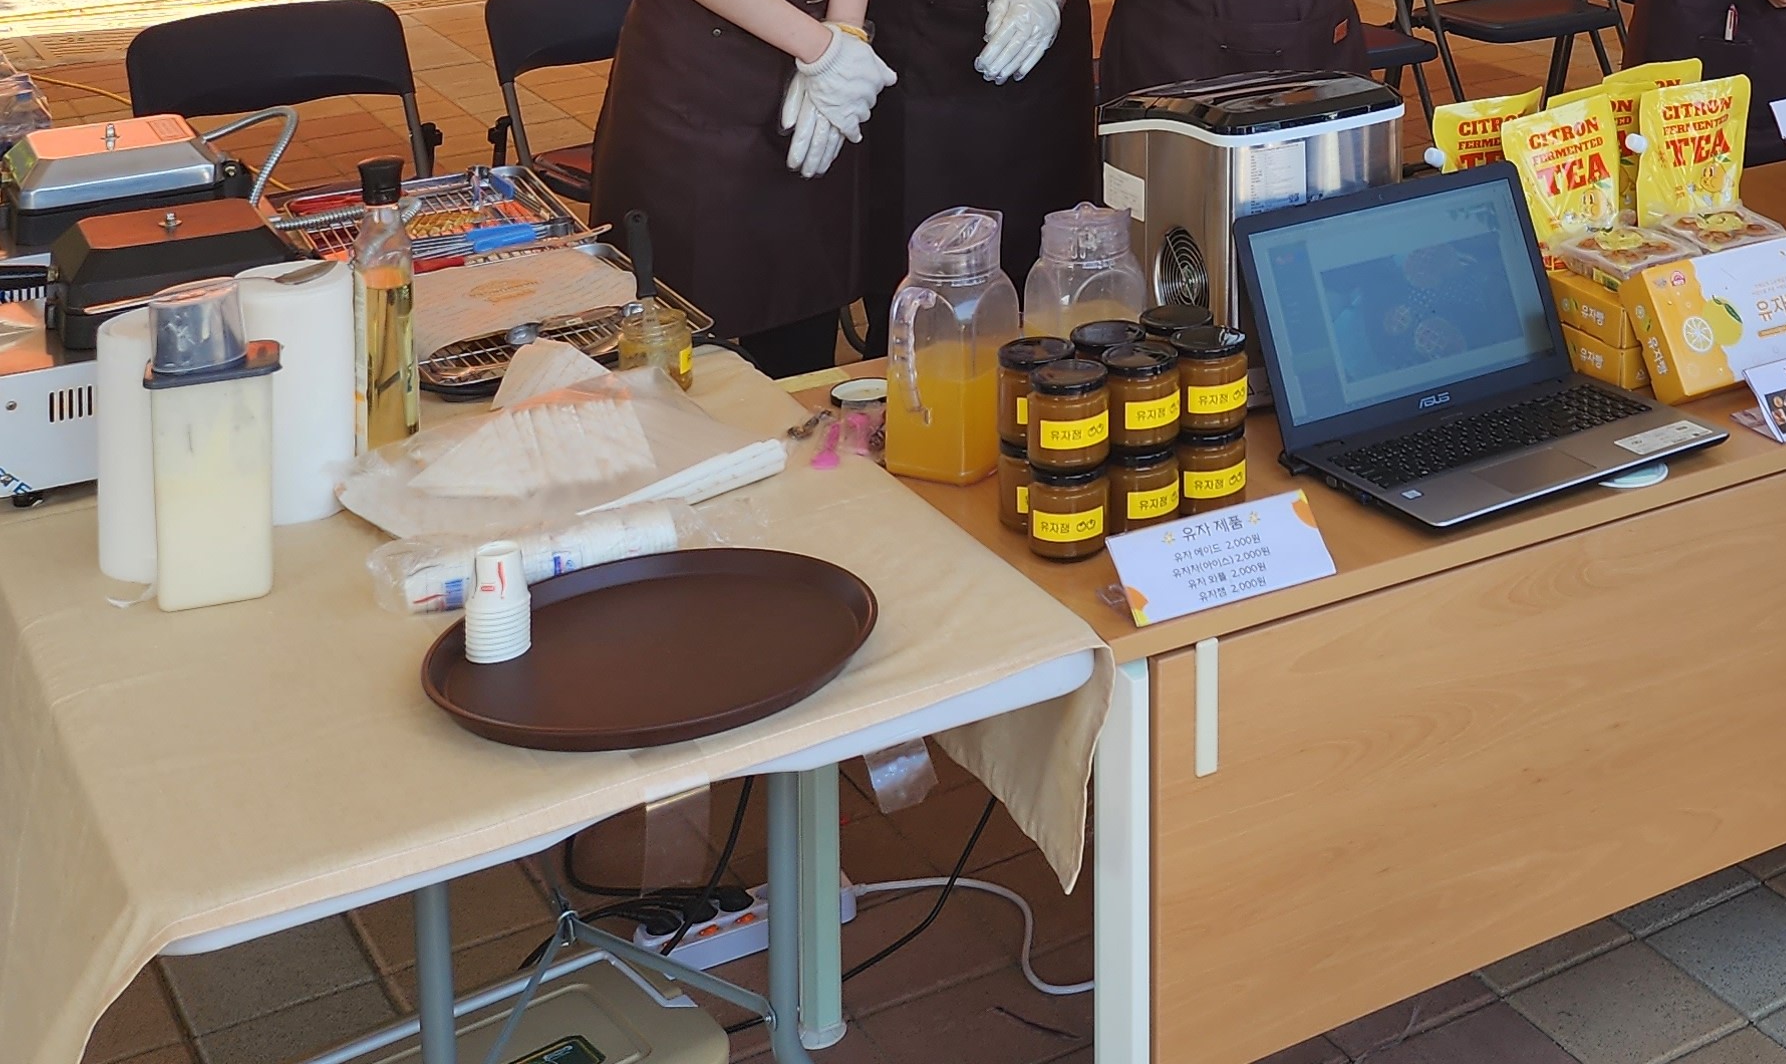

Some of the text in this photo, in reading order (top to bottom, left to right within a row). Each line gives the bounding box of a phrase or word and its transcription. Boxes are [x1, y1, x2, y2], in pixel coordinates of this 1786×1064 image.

[1662, 96, 1733, 121] CITRON
[1528, 117, 1600, 150] CITRON
[1663, 114, 1729, 136] FERMENTED
[1531, 136, 1604, 167] FERMENTED
[1665, 128, 1731, 168] TEA
[1537, 152, 1611, 197] TEA
[1581, 304, 1605, 326] 유자빵
[1580, 347, 1604, 369] 유자빵
[1648, 336, 1669, 375] 유자빵
[1418, 391, 1451, 409] ASUS
[1182, 515, 1244, 542] 유자 제품
[1173, 551, 1193, 563] 유자
[1193, 543, 1223, 558] 에이드
[1188, 578, 1208, 589] 유자
